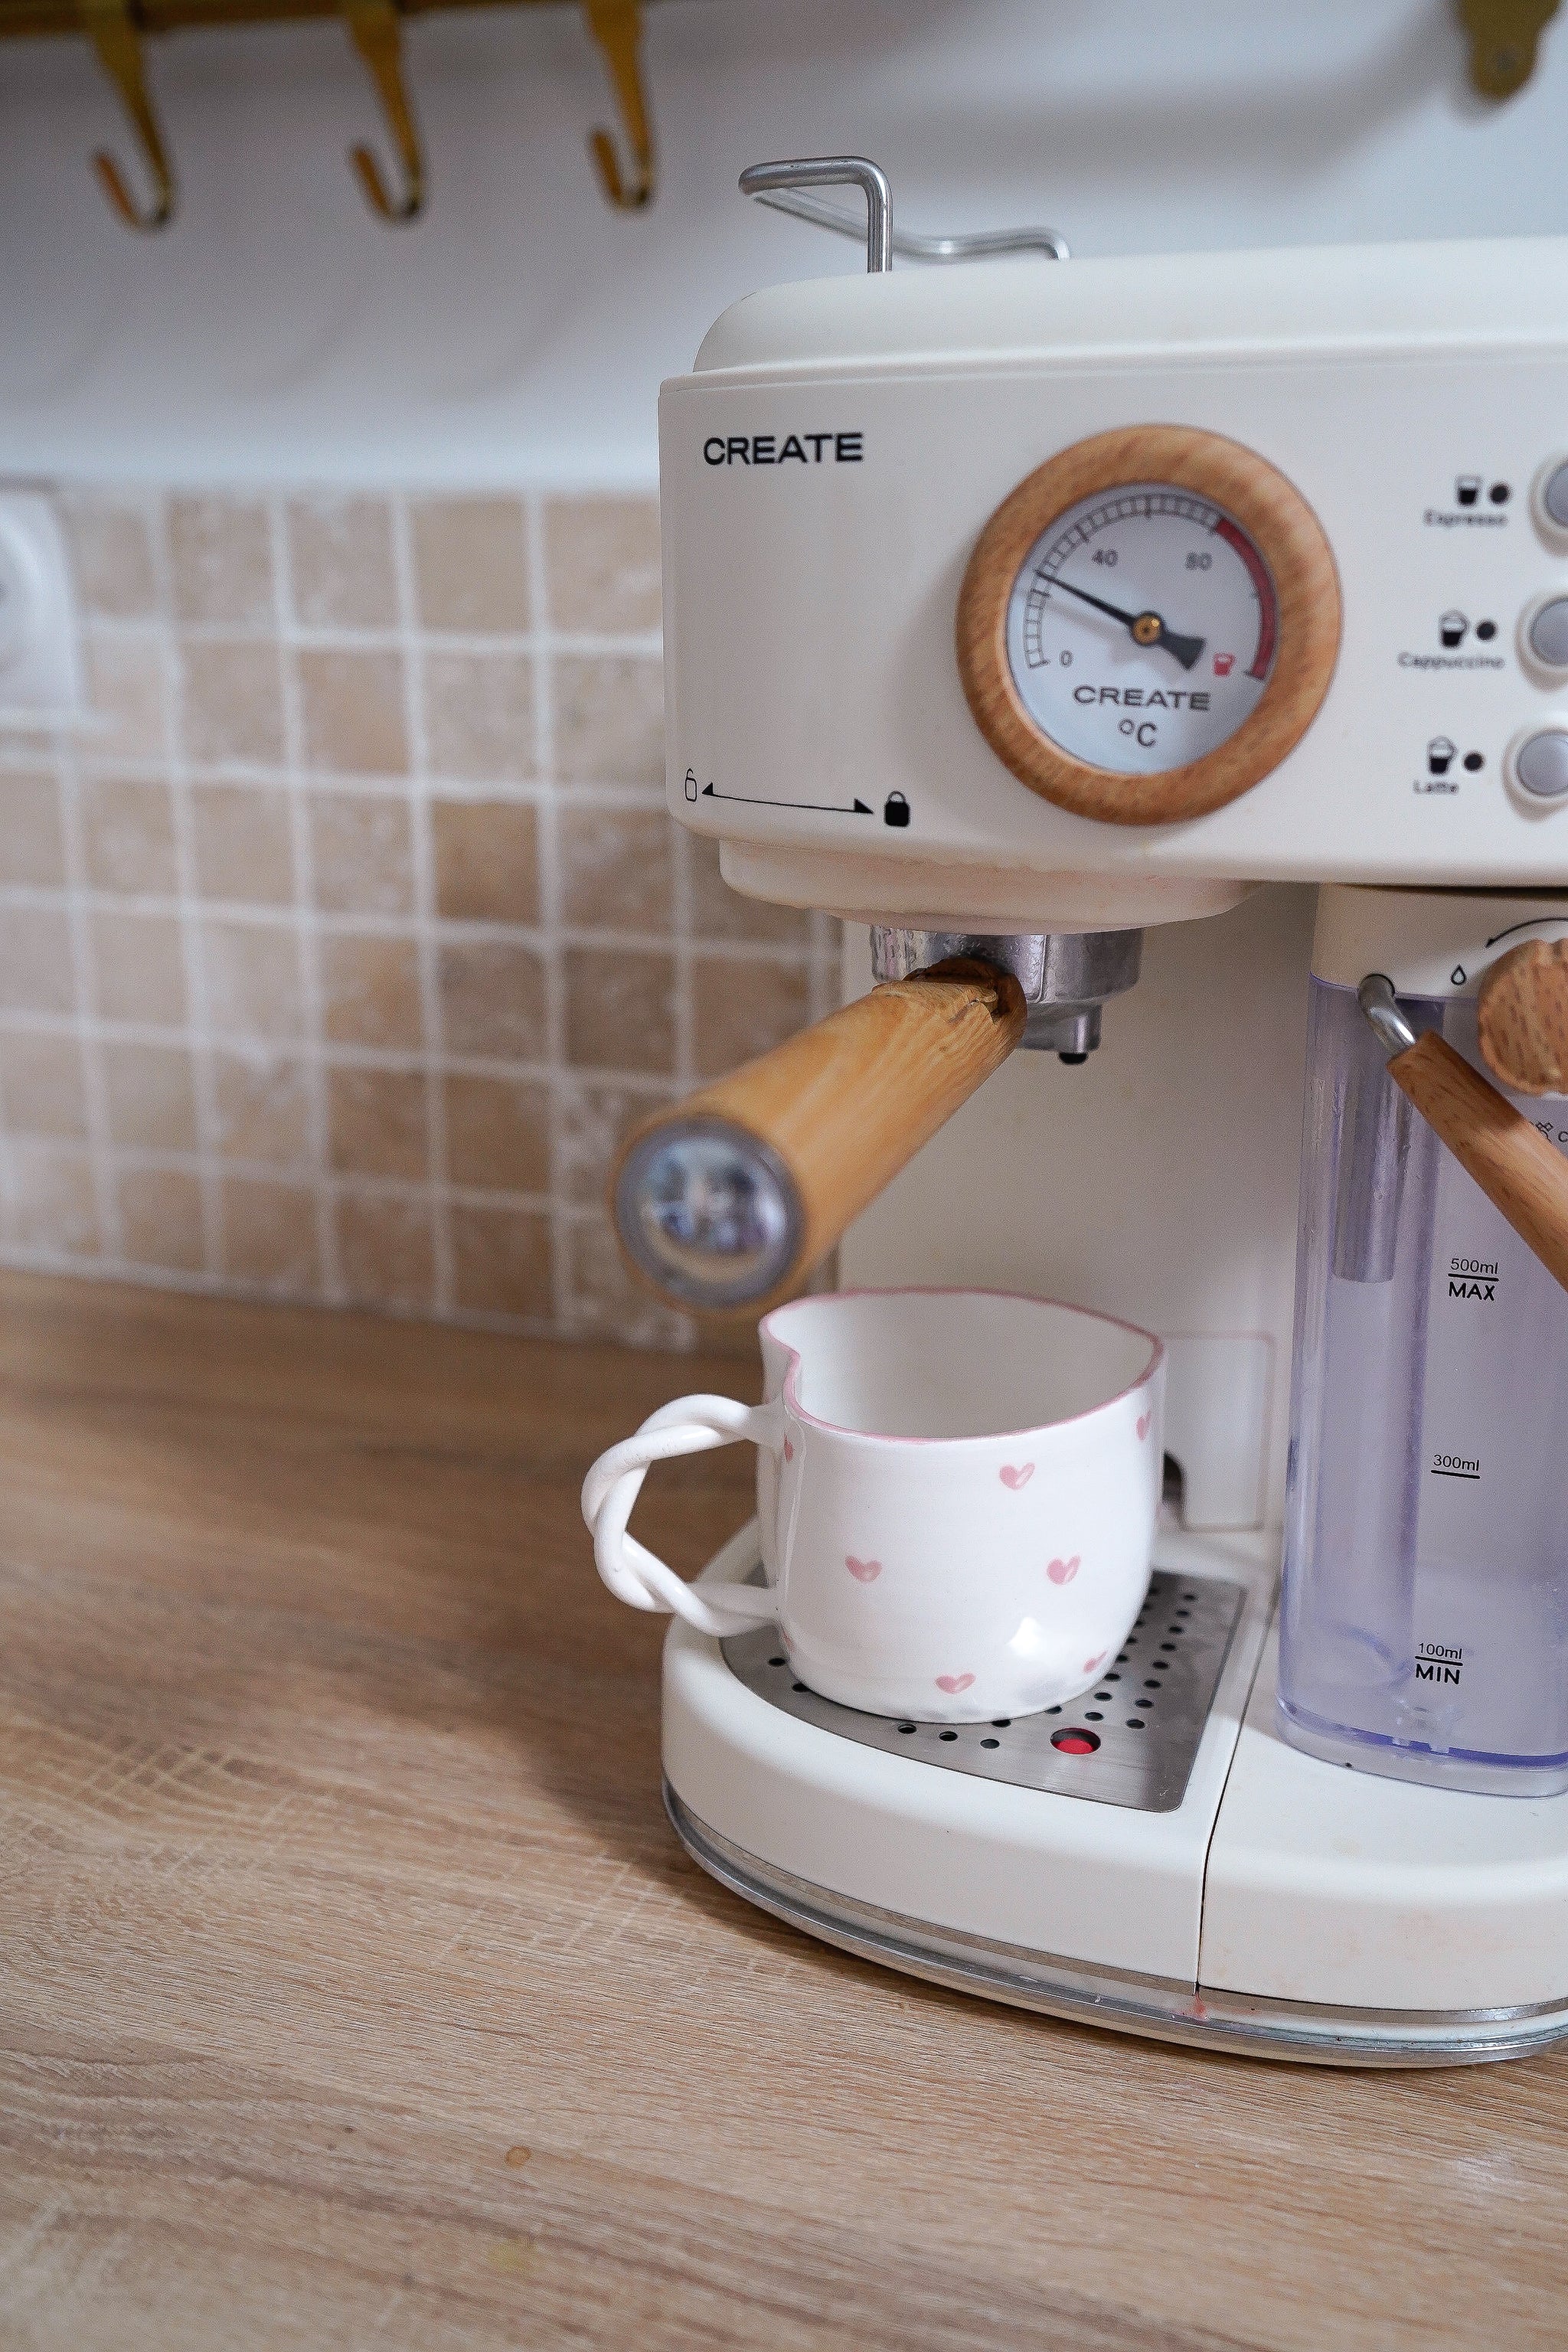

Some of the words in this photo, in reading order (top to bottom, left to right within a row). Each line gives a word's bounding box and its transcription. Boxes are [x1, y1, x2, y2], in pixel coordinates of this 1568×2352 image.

[703, 432, 864, 466] CREATE
[1091, 549, 1119, 568] 40
[1185, 552, 1214, 571] 80
[1059, 650, 1073, 667] 0
[1073, 685, 1210, 711] CREATE
[1118, 718, 1157, 747] °C
[1451, 1258, 1498, 1274] 500ml
[1449, 1281, 1495, 1301] MAX
[1433, 1454, 1479, 1471] 300ml
[1418, 1642, 1462, 1660] 100ml
[1415, 1663, 1460, 1684] MIN
